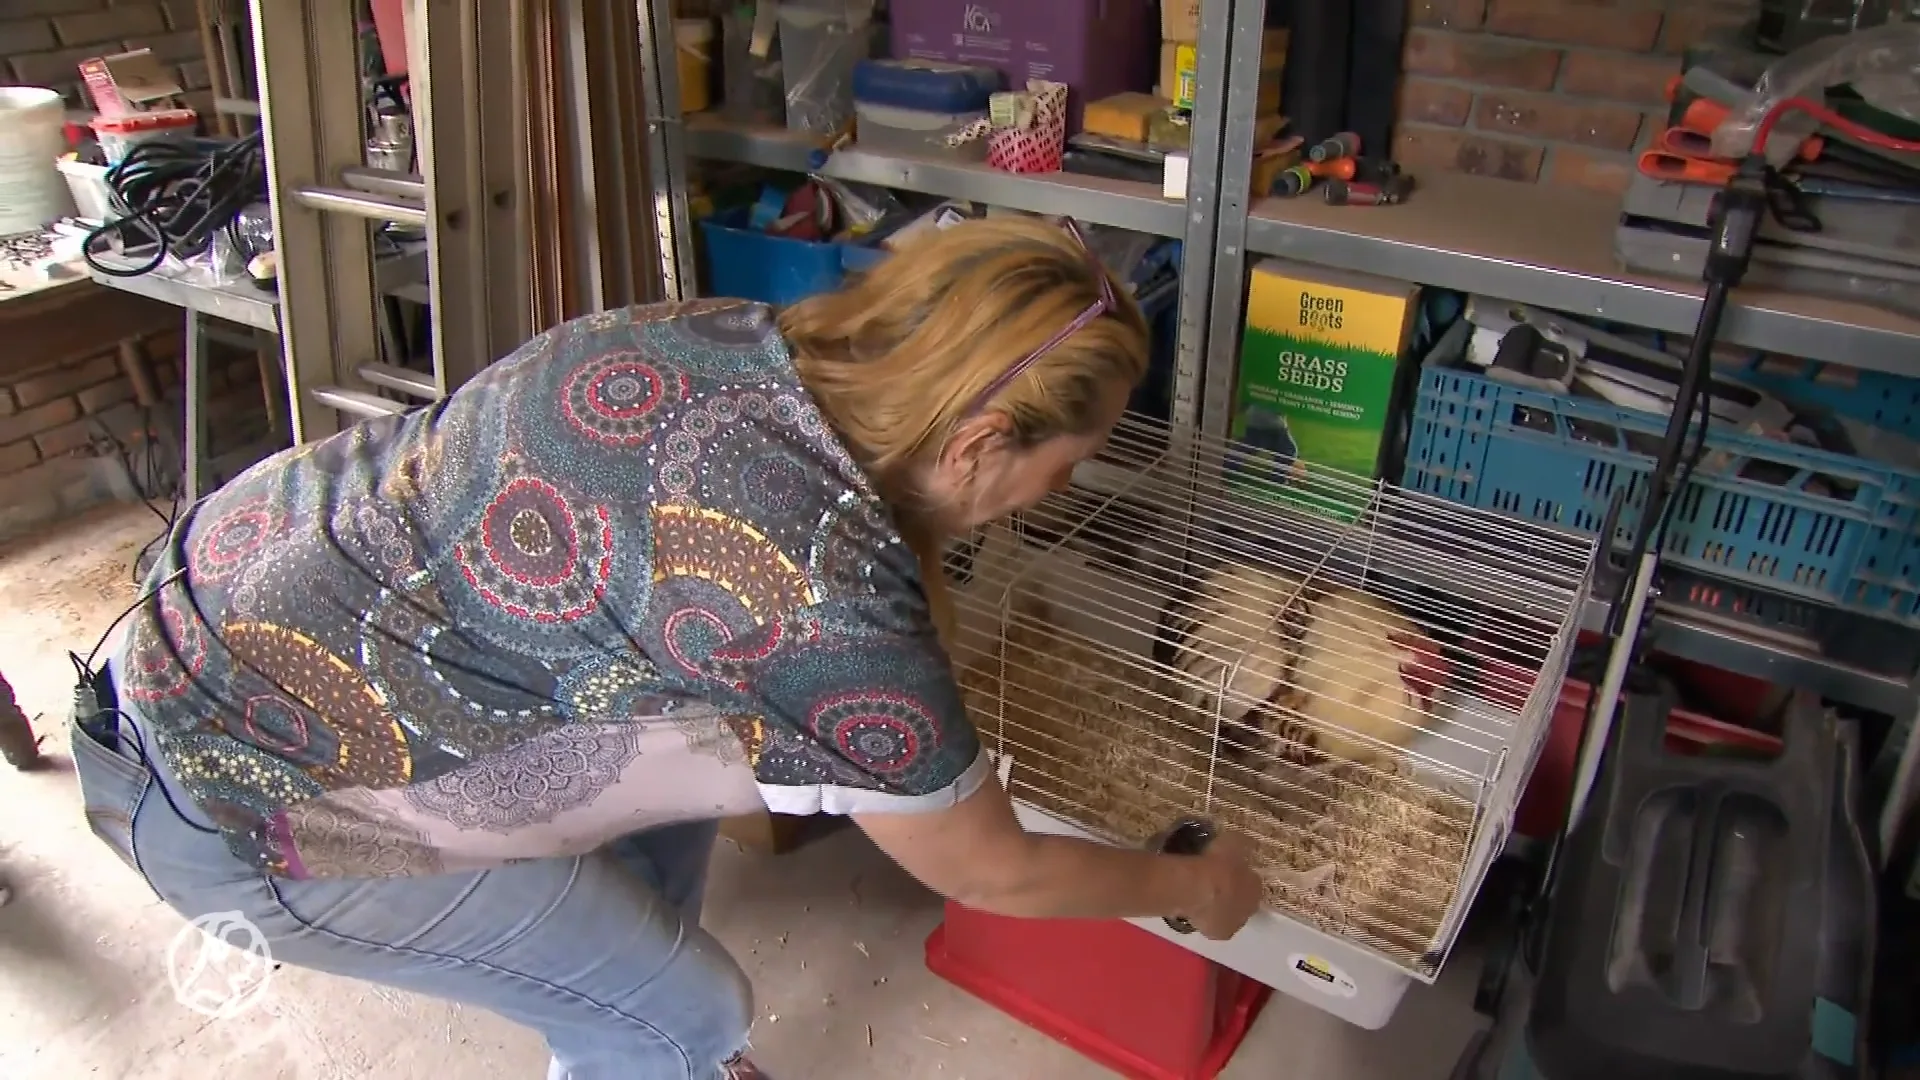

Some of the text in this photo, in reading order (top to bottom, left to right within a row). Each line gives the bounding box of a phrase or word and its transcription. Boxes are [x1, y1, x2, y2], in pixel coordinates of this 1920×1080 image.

[1299, 291, 1344, 313] Green
[1279, 351, 1348, 377] GRASS
[1278, 367, 1344, 393] SEEDS
